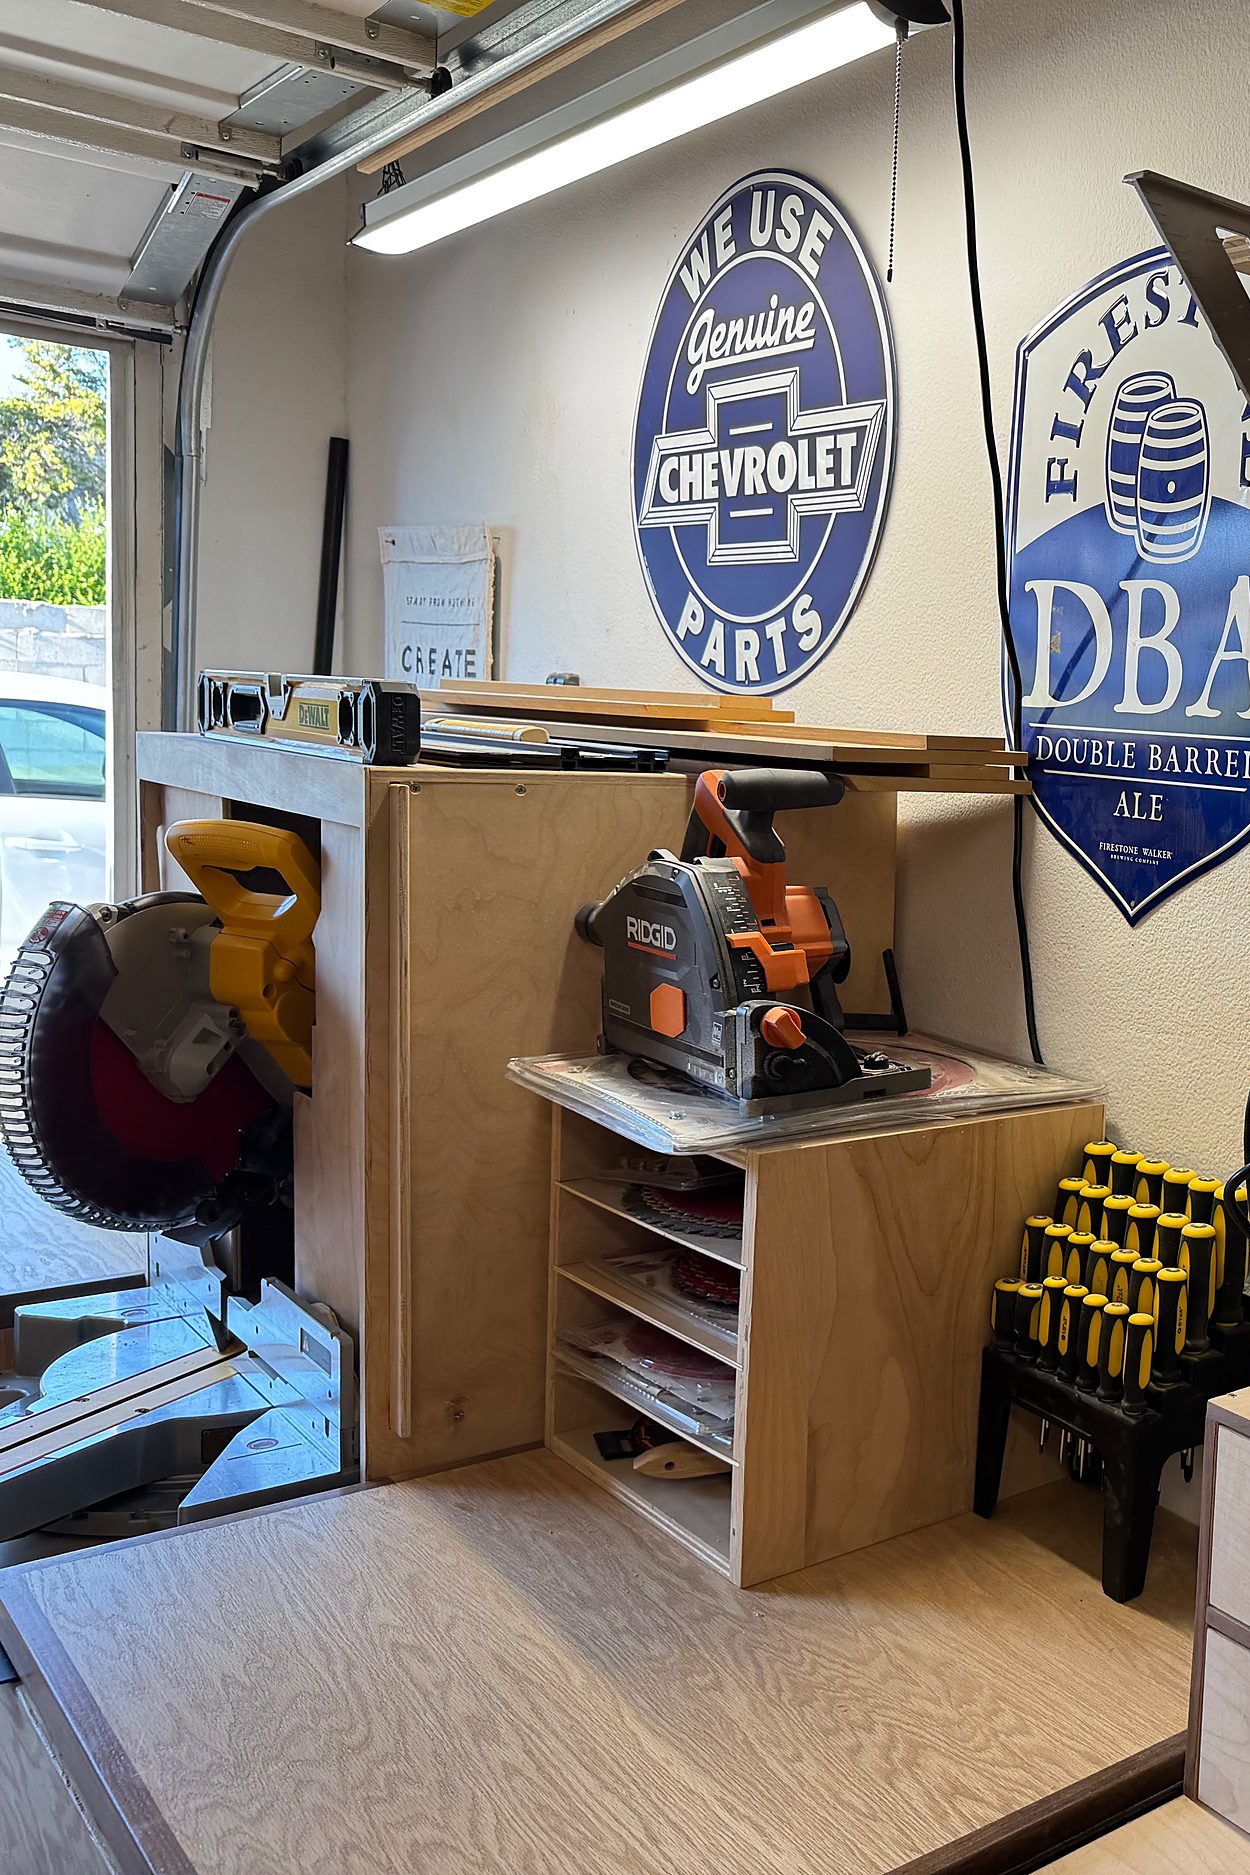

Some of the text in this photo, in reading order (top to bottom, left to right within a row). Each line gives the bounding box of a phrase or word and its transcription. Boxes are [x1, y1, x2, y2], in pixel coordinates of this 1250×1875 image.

[679, 189, 834, 303] WE USE
[685, 292, 817, 395] Genuine
[659, 430, 859, 503] CHEVROLET
[675, 590, 824, 682] PARTS
[401, 645, 477, 678] CREATE
[1036, 735, 1137, 769] DOUBLE
[1113, 790, 1164, 821] ALE
[1098, 841, 1139, 855] FIRESTONE
[627, 915, 677, 952] RIDGID
